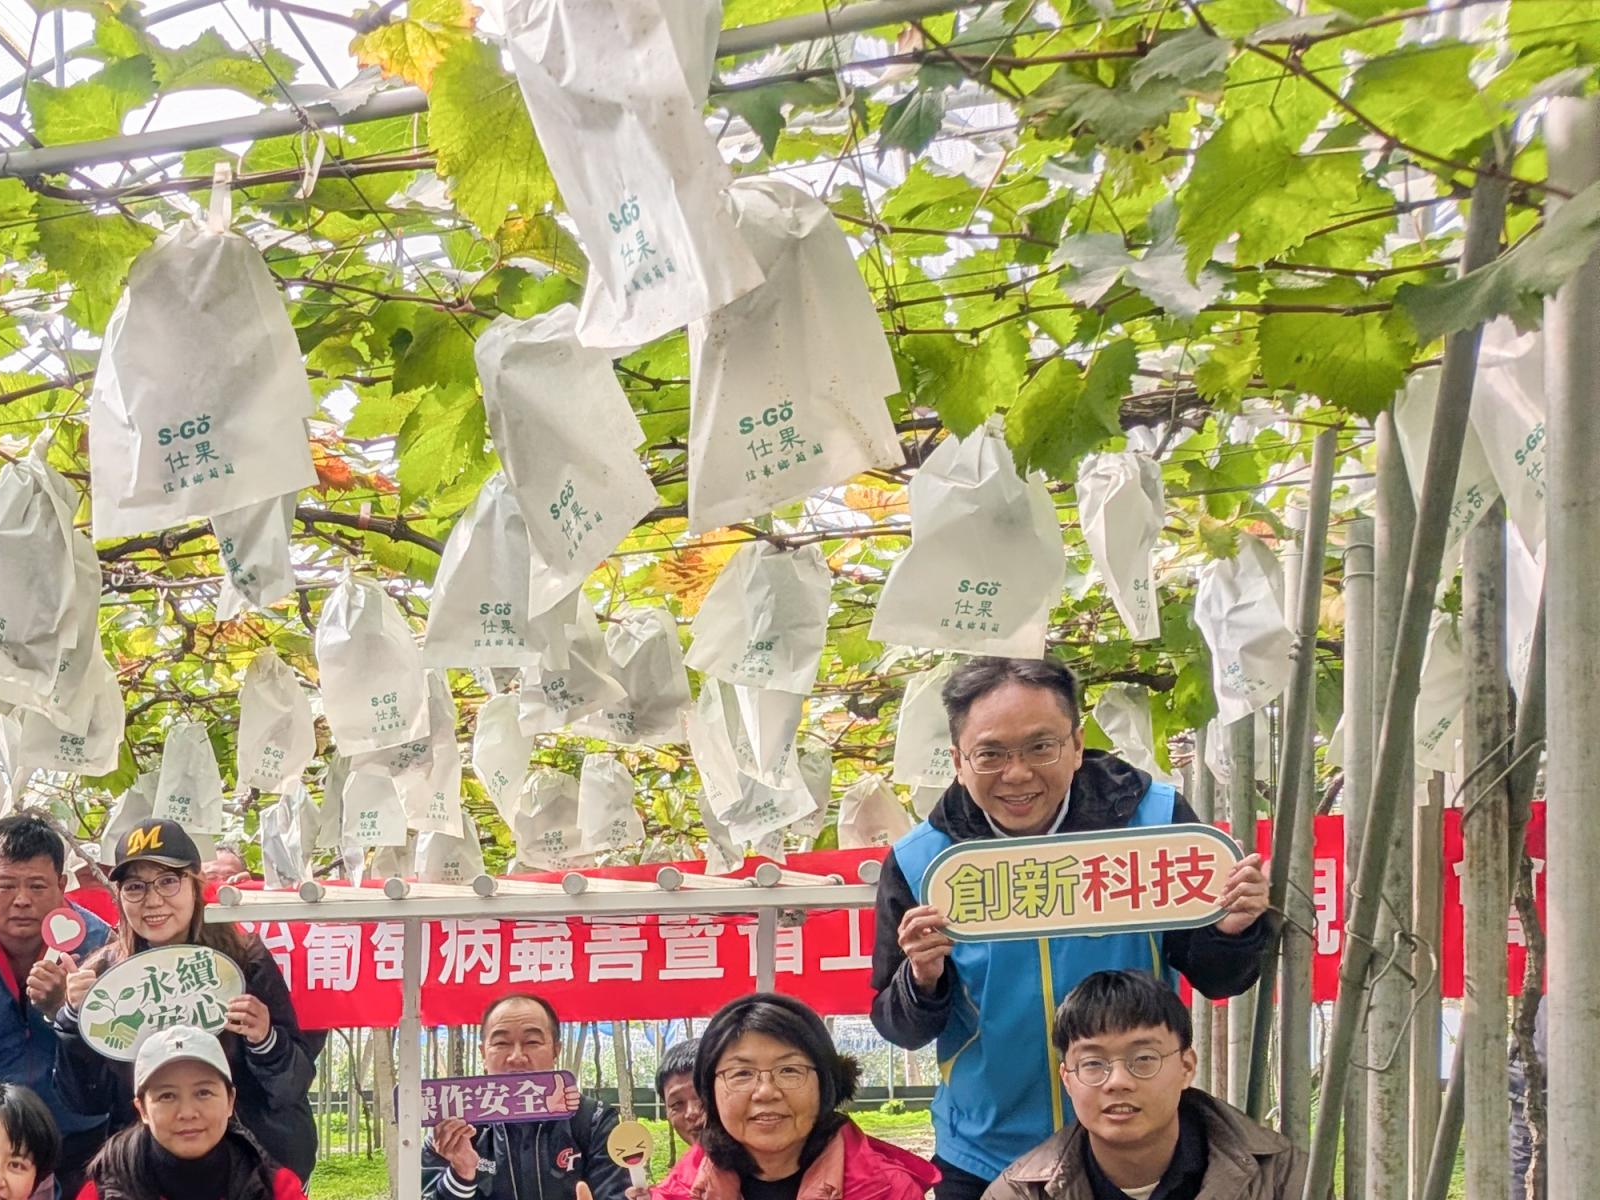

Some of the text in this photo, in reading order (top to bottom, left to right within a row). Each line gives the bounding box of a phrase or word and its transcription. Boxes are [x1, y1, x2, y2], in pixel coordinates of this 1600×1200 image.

[620, 231, 656, 268] 仕果
[164, 441, 219, 474] 仕果
[747, 426, 806, 460] 仕果
[1526, 461, 1544, 481] 仕
[561, 501, 588, 540] 仕果
[954, 599, 994, 617] 仕果
[481, 619, 516, 635] 仕果
[375, 706, 401, 722] 仕果
[127, 826, 163, 856] M
[947, 847, 1218, 922] 創新科技
[136, 950, 219, 1004] 永續
